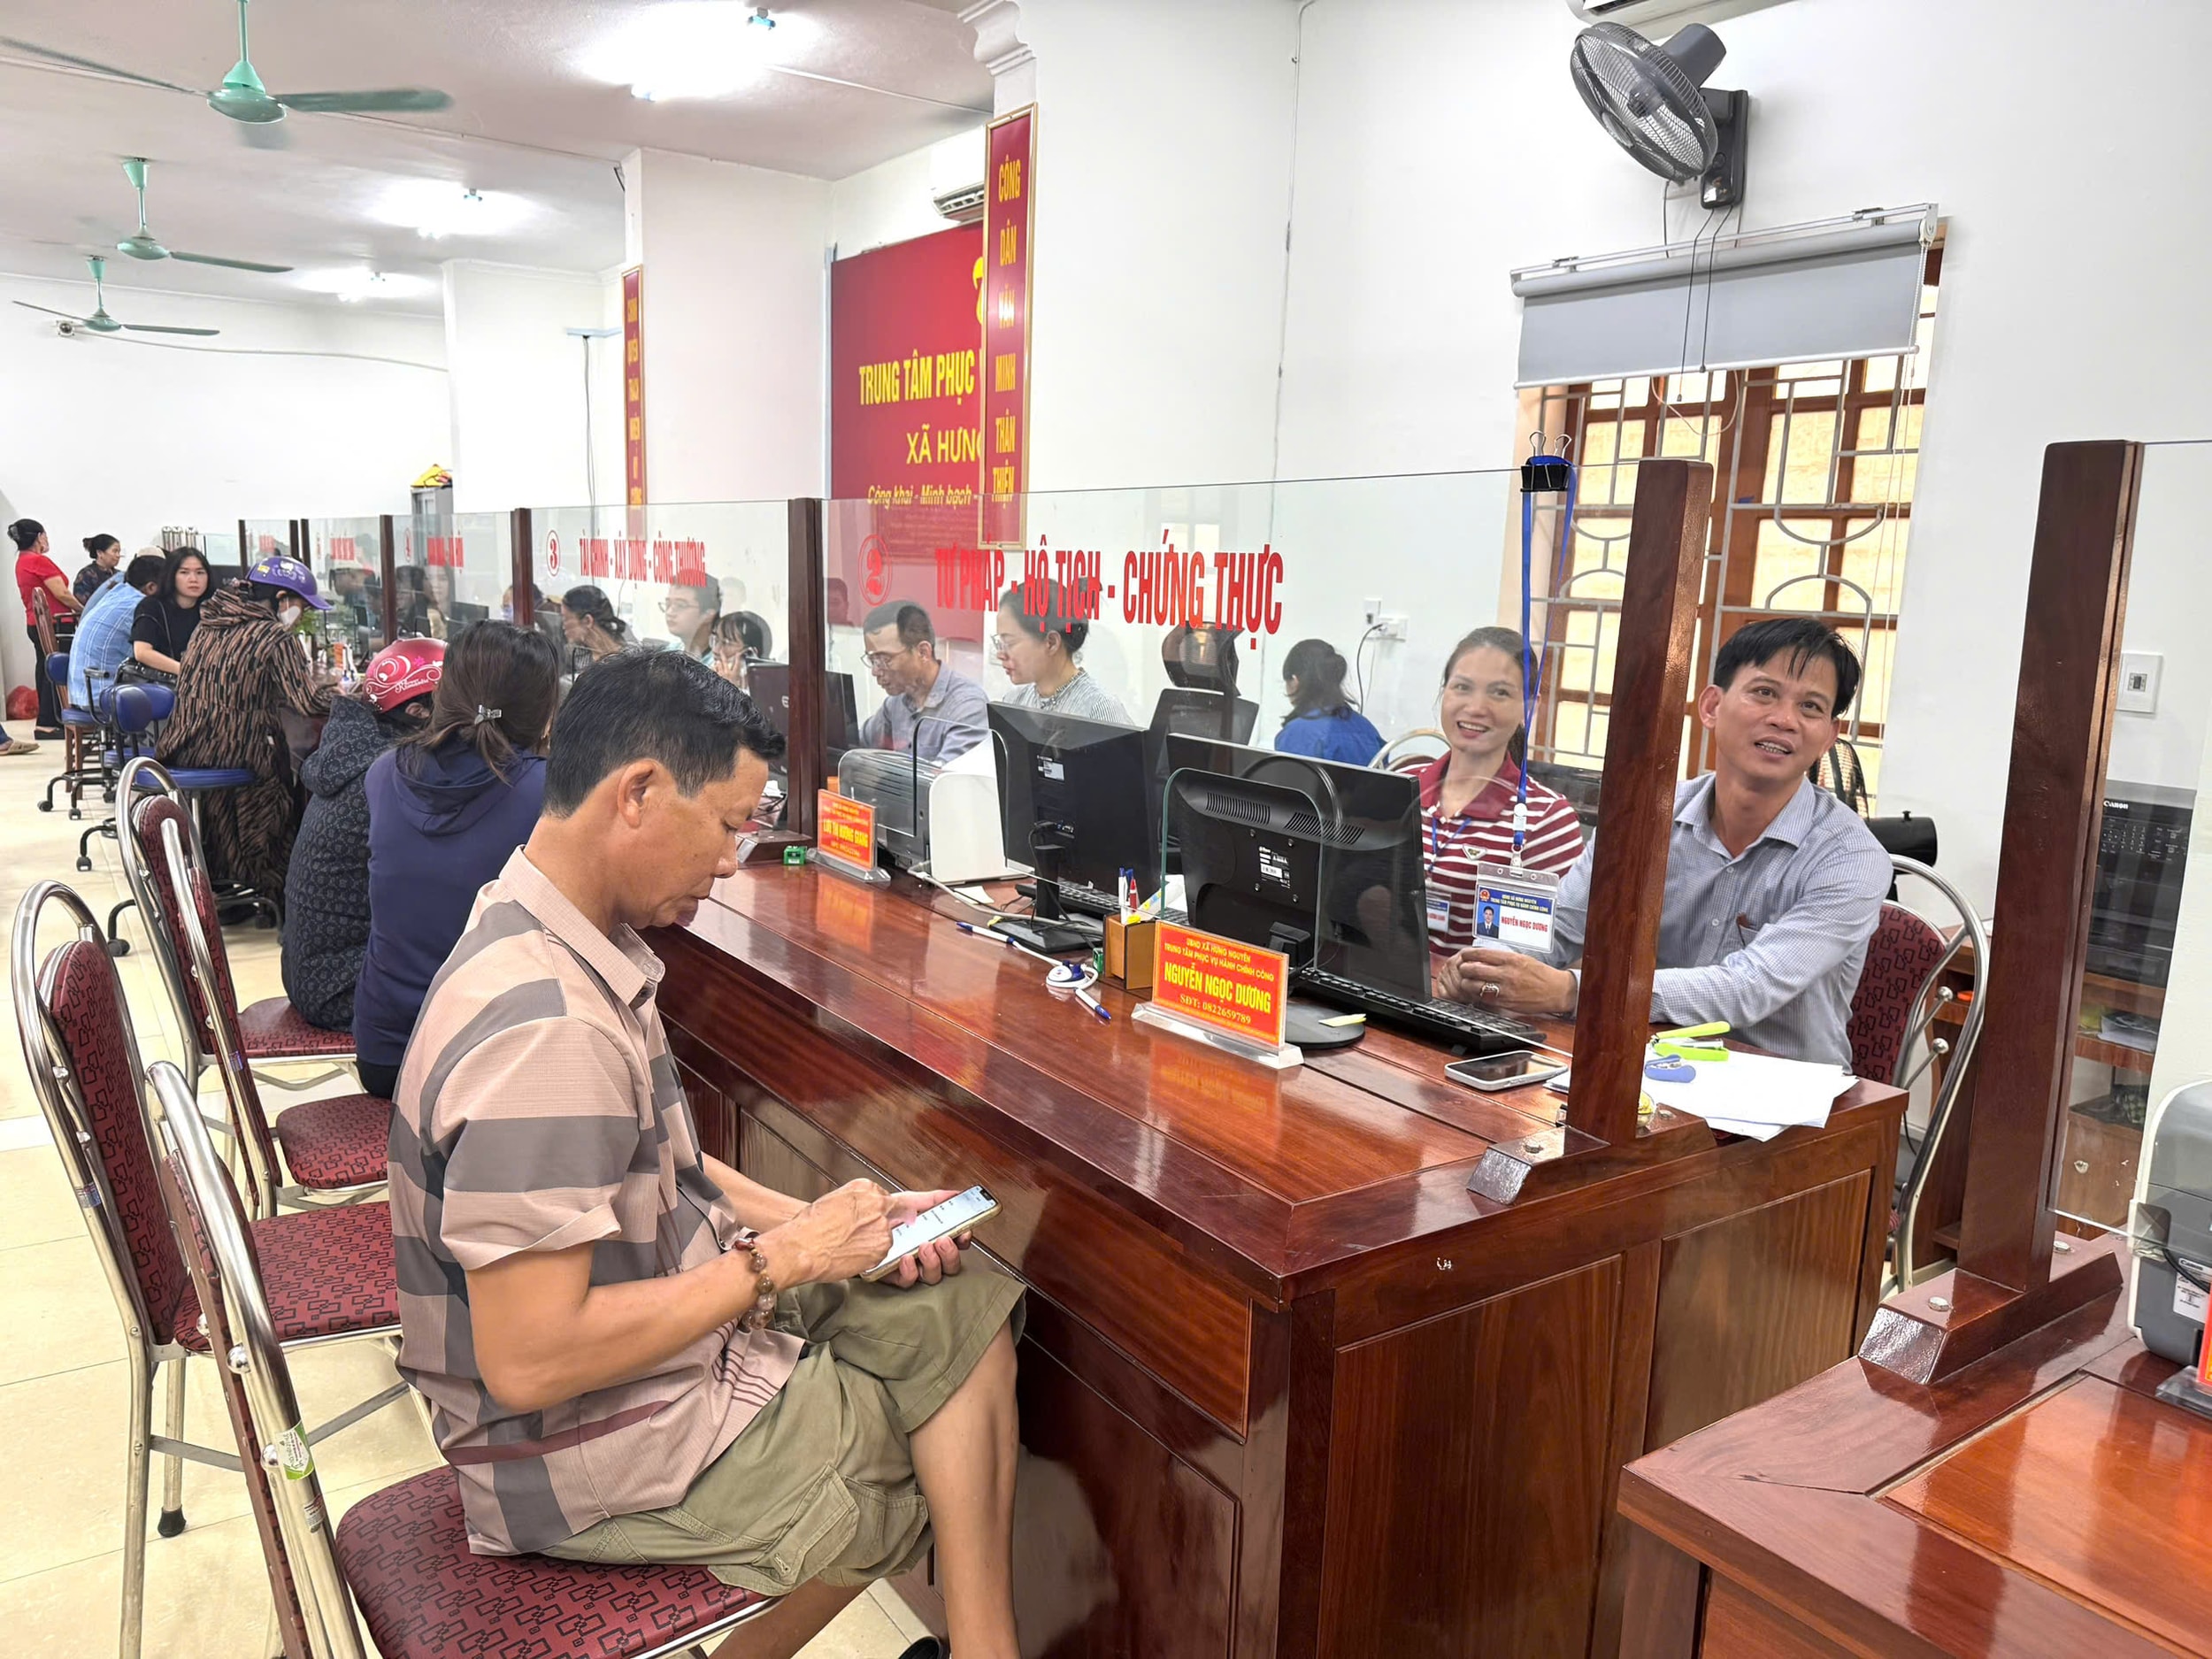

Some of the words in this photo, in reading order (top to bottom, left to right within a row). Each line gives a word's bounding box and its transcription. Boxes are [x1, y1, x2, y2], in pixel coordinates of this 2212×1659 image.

[998, 153, 1021, 204] CÔNG
[1000, 219, 1017, 266] DÂN
[859, 361, 900, 405] TRUNG
[903, 349, 933, 400] TÂM
[936, 349, 975, 405] PHỤC
[995, 353, 1016, 392] MINH
[906, 423, 933, 465] XÃ
[995, 408, 1016, 454] THÂN
[867, 484, 892, 510] Công
[893, 485, 913, 505] khai
[920, 484, 944, 505] Minh
[946, 484, 972, 510] bạch
[992, 459, 1015, 510] THIỆN
[653, 530, 673, 585] CÔNG
[675, 536, 706, 588] THƯƠNG
[864, 548, 882, 595] 2
[934, 541, 957, 609] TƯ
[959, 533, 1005, 611] PHÁP
[1025, 534, 1049, 634] HỘ
[1055, 549, 1101, 634] TỊCH
[1123, 529, 1205, 628] CHỨNG
[1214, 543, 1284, 649] THỰC
[2103, 801, 2129, 810] Canon
[1182, 947, 1193, 958] TÂM
[1194, 951, 1210, 964] PHỤC
[1210, 956, 1219, 968] VỤ
[1218, 957, 1234, 970] HÀNH
[1236, 963, 1256, 976] CHÍNH
[1256, 969, 1274, 982] CÔNG
[1164, 962, 1202, 993] NGUYỄN
[1205, 973, 1233, 1003] NGỌC
[1235, 982, 1271, 1014] DƯƠNG
[1179, 994, 1201, 1009] SĐT:
